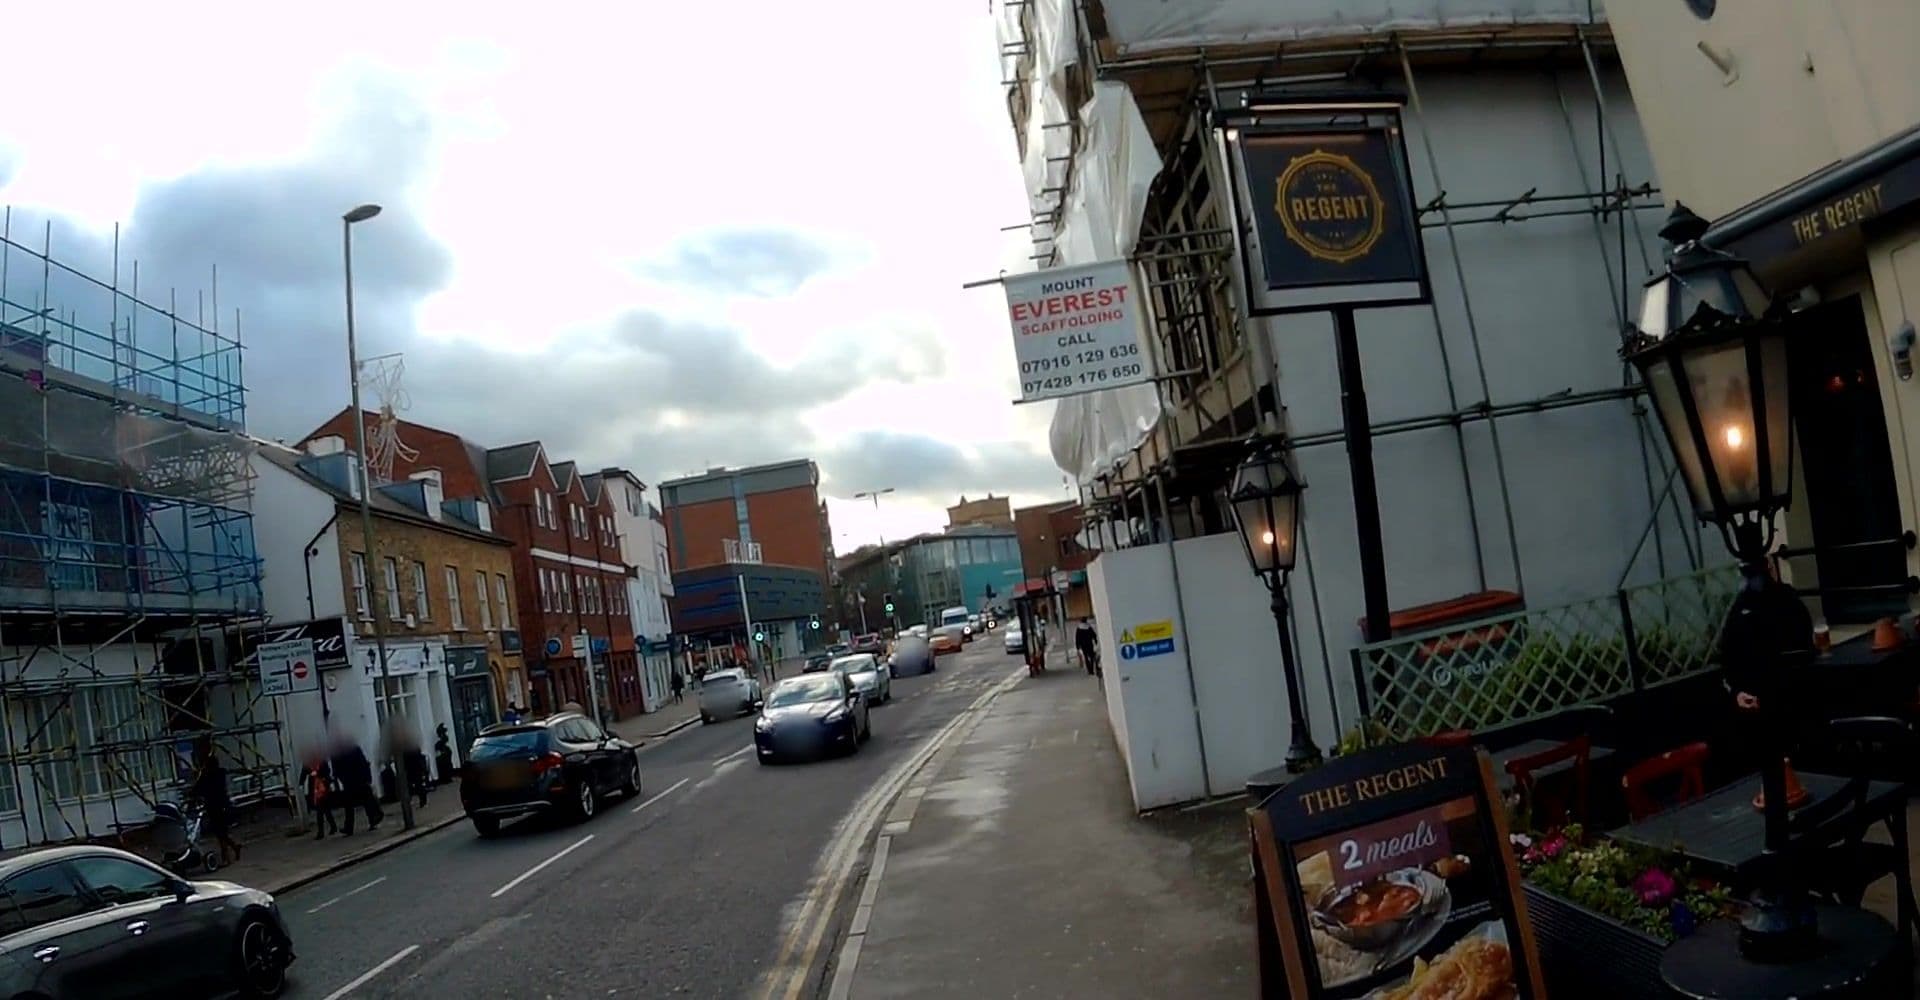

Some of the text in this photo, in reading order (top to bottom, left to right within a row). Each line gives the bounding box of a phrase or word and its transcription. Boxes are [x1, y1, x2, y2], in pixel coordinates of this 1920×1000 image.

[1291, 195, 1368, 221] REGENT
[1792, 183, 1882, 243] THE REGENT
[1042, 276, 1095, 294] MOUNT
[1011, 285, 1128, 321] EVEREST
[1021, 310, 1123, 335] SCAFFOLDING
[1057, 332, 1096, 347] CALL
[1022, 344, 1138, 374] 07916 129 636
[1024, 364, 1141, 393] 07428 176 650
[1300, 756, 1448, 815] THE REGENT
[1340, 820, 1438, 870] 2 meals
